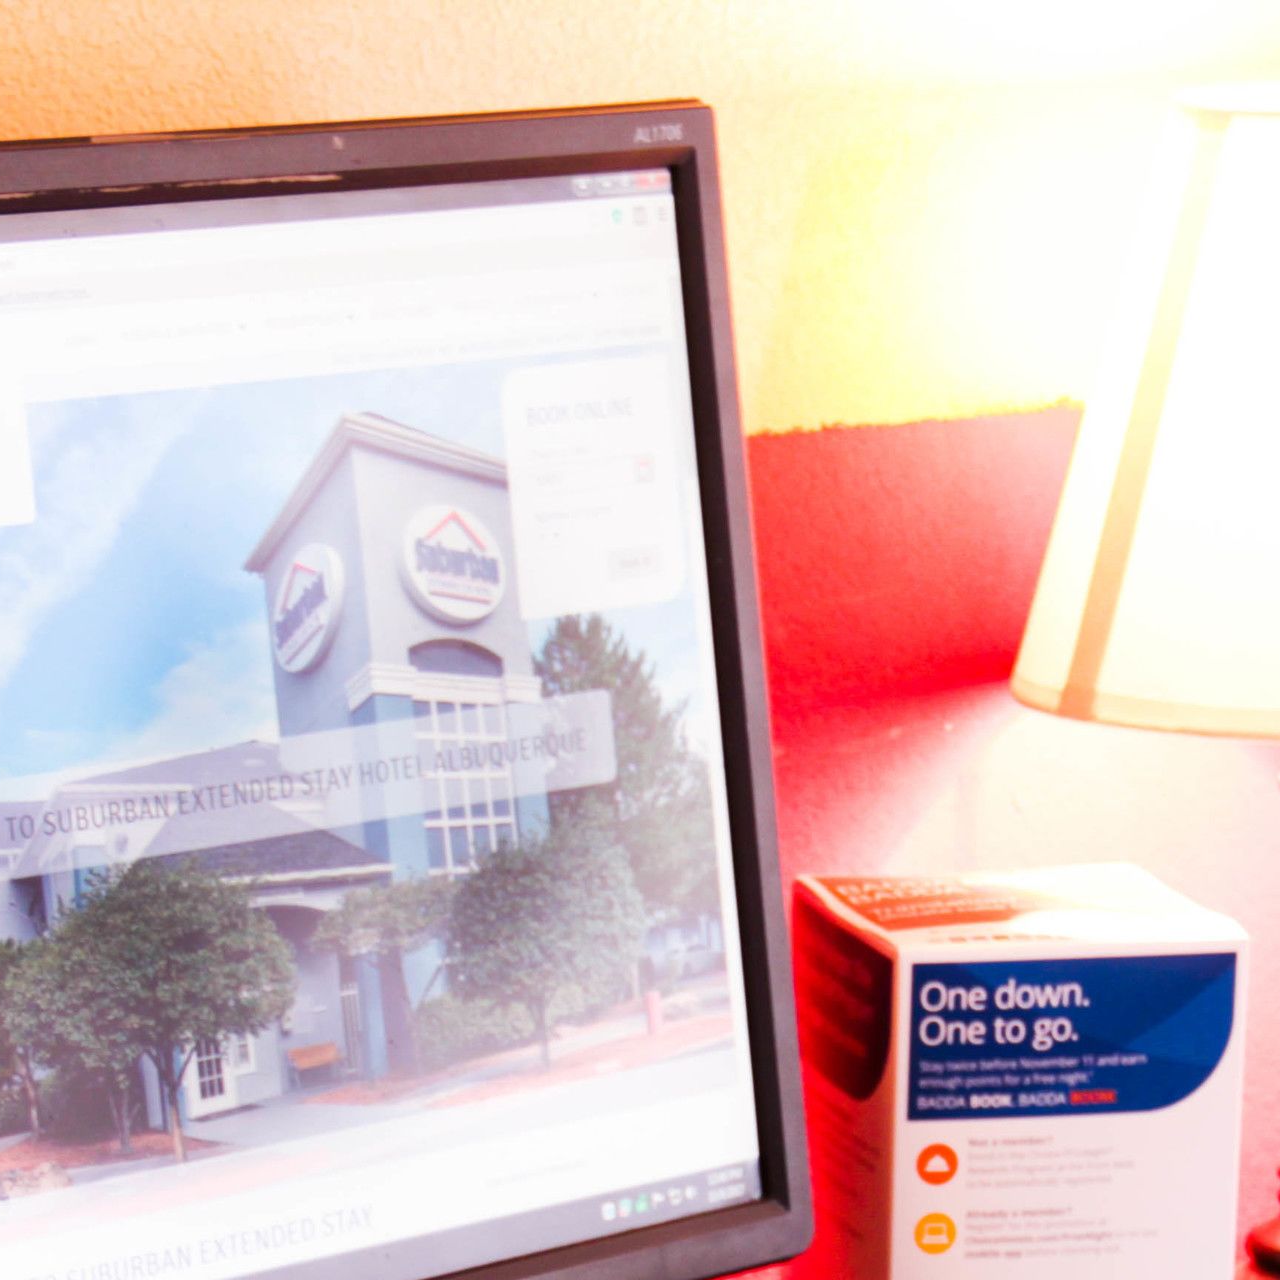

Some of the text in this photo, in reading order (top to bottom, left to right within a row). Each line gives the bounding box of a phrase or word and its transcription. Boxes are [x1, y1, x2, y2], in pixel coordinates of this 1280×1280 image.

[5, 815, 35, 843] TO
[43, 792, 170, 836] SUBURBAN
[177, 774, 294, 816] EXTENDED
[301, 766, 354, 797] STAY
[359, 759, 421, 787] HOTEL
[433, 728, 588, 774] ALBUQUERQUE
[919, 976, 1091, 1013] One down.
[919, 1015, 1080, 1052] One to go.
[200, 1217, 316, 1264] EXTENDED
[320, 1204, 374, 1238] STAY
